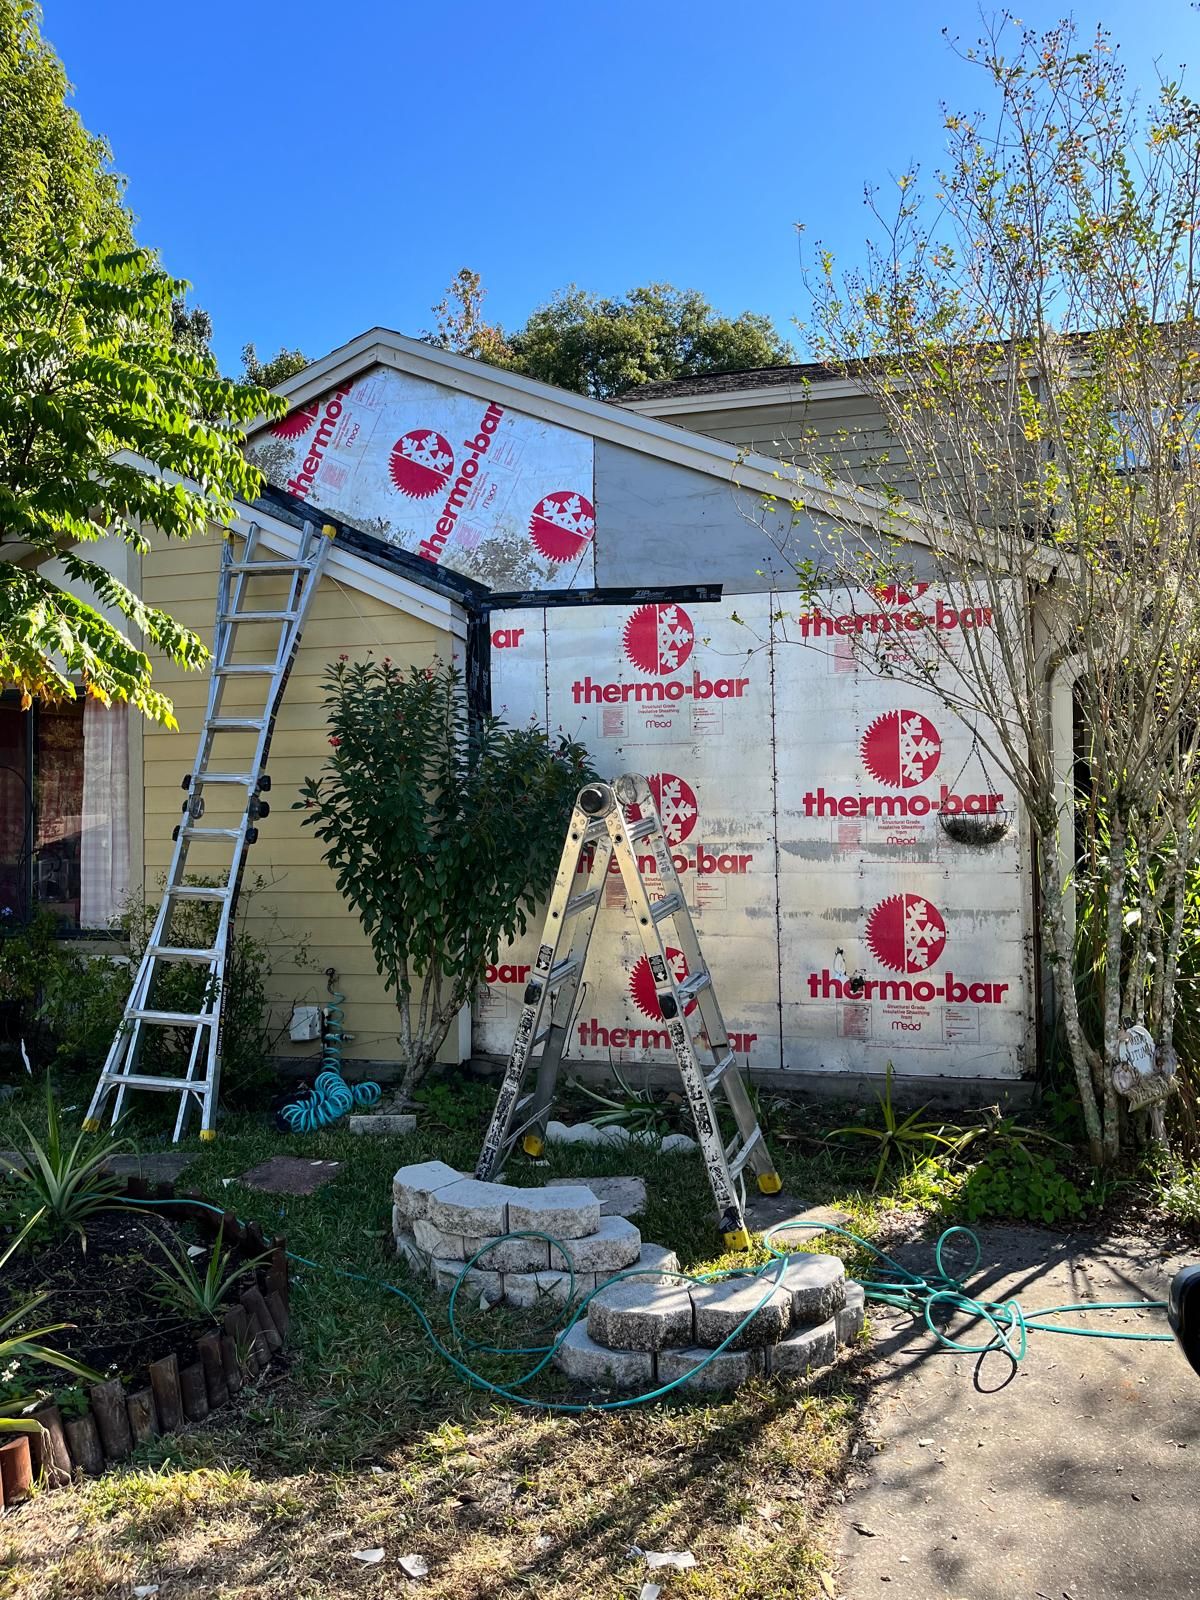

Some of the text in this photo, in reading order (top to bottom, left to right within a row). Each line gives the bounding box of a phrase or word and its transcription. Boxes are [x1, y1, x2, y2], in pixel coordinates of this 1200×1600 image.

[418, 401, 504, 562] thermo-bar
[490, 628, 525, 649] ar
[572, 671, 749, 704] thermo-bar
[646, 719, 672, 728] Mead
[802, 785, 1005, 817] thermo-bar
[887, 836, 916, 845] Mead
[807, 969, 1009, 1004] thermo-bar
[892, 1021, 921, 1031] Mead
